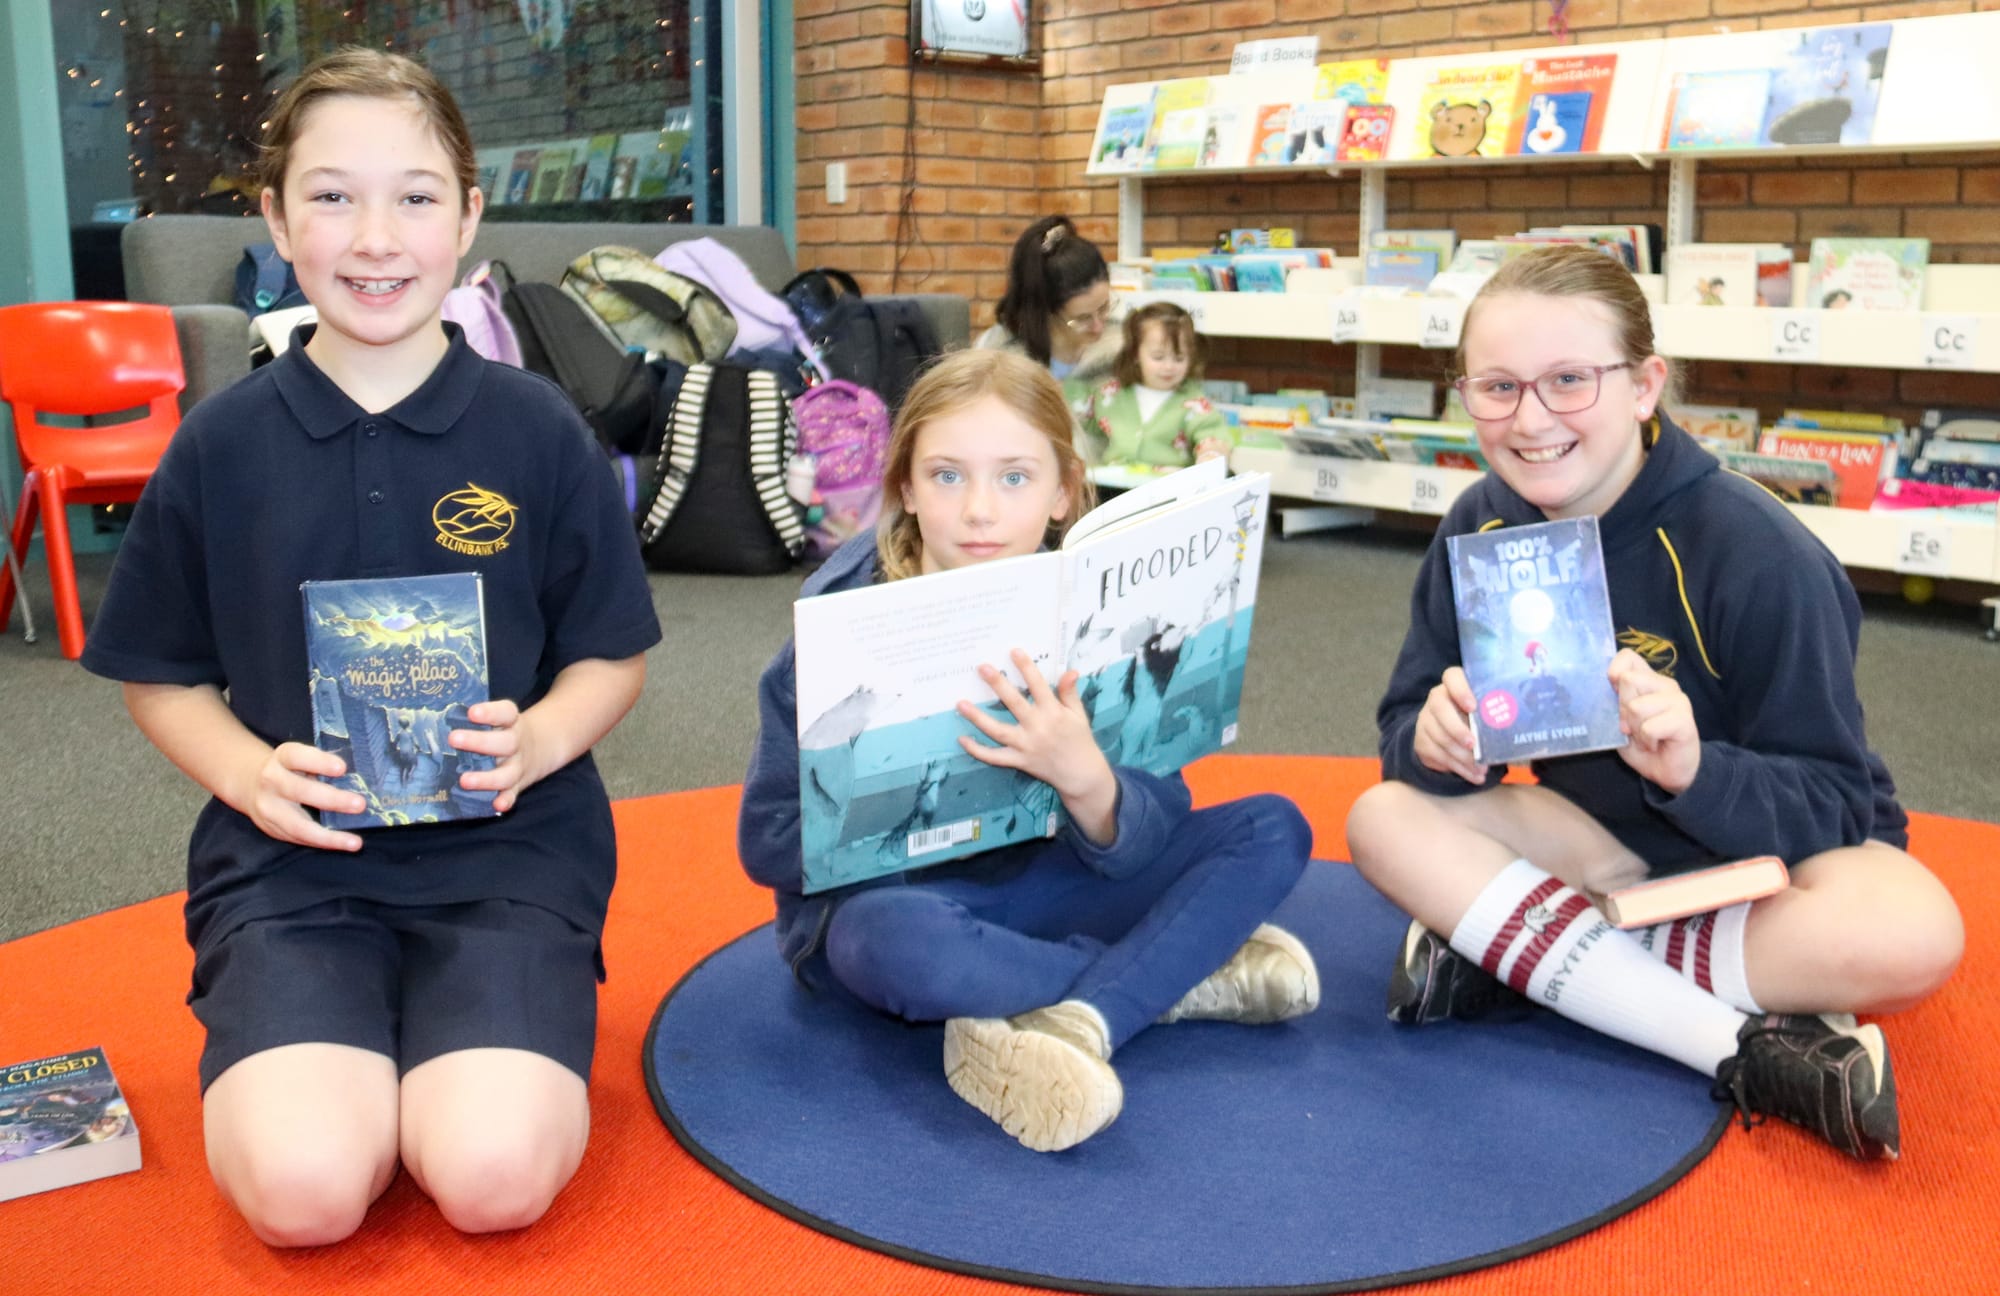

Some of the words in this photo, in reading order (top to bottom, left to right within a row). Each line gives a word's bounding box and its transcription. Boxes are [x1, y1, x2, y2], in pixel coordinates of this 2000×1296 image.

[1232, 50, 1268, 65] Boad
[1272, 48, 1314, 61] Books
[1337, 309, 1357, 326] Aa
[1427, 314, 1449, 333] Aa
[1783, 320, 1811, 343] Cc
[1934, 326, 1966, 351] Cc
[1317, 468, 1338, 489] Bb
[1415, 479, 1438, 499] Bb
[435, 533, 493, 556] ELLINBANK
[1494, 535, 1553, 562] 100%
[1910, 531, 1940, 556] Ee
[1099, 526, 1223, 612] FLOODED
[1467, 538, 1582, 593] WOLF
[370, 655, 386, 668] the
[346, 669, 406, 697] magic
[408, 658, 459, 691] place
[1513, 729, 1549, 744] JAYNE
[1551, 725, 1588, 740] LYONS
[7, 1056, 98, 1083] CLOSED
